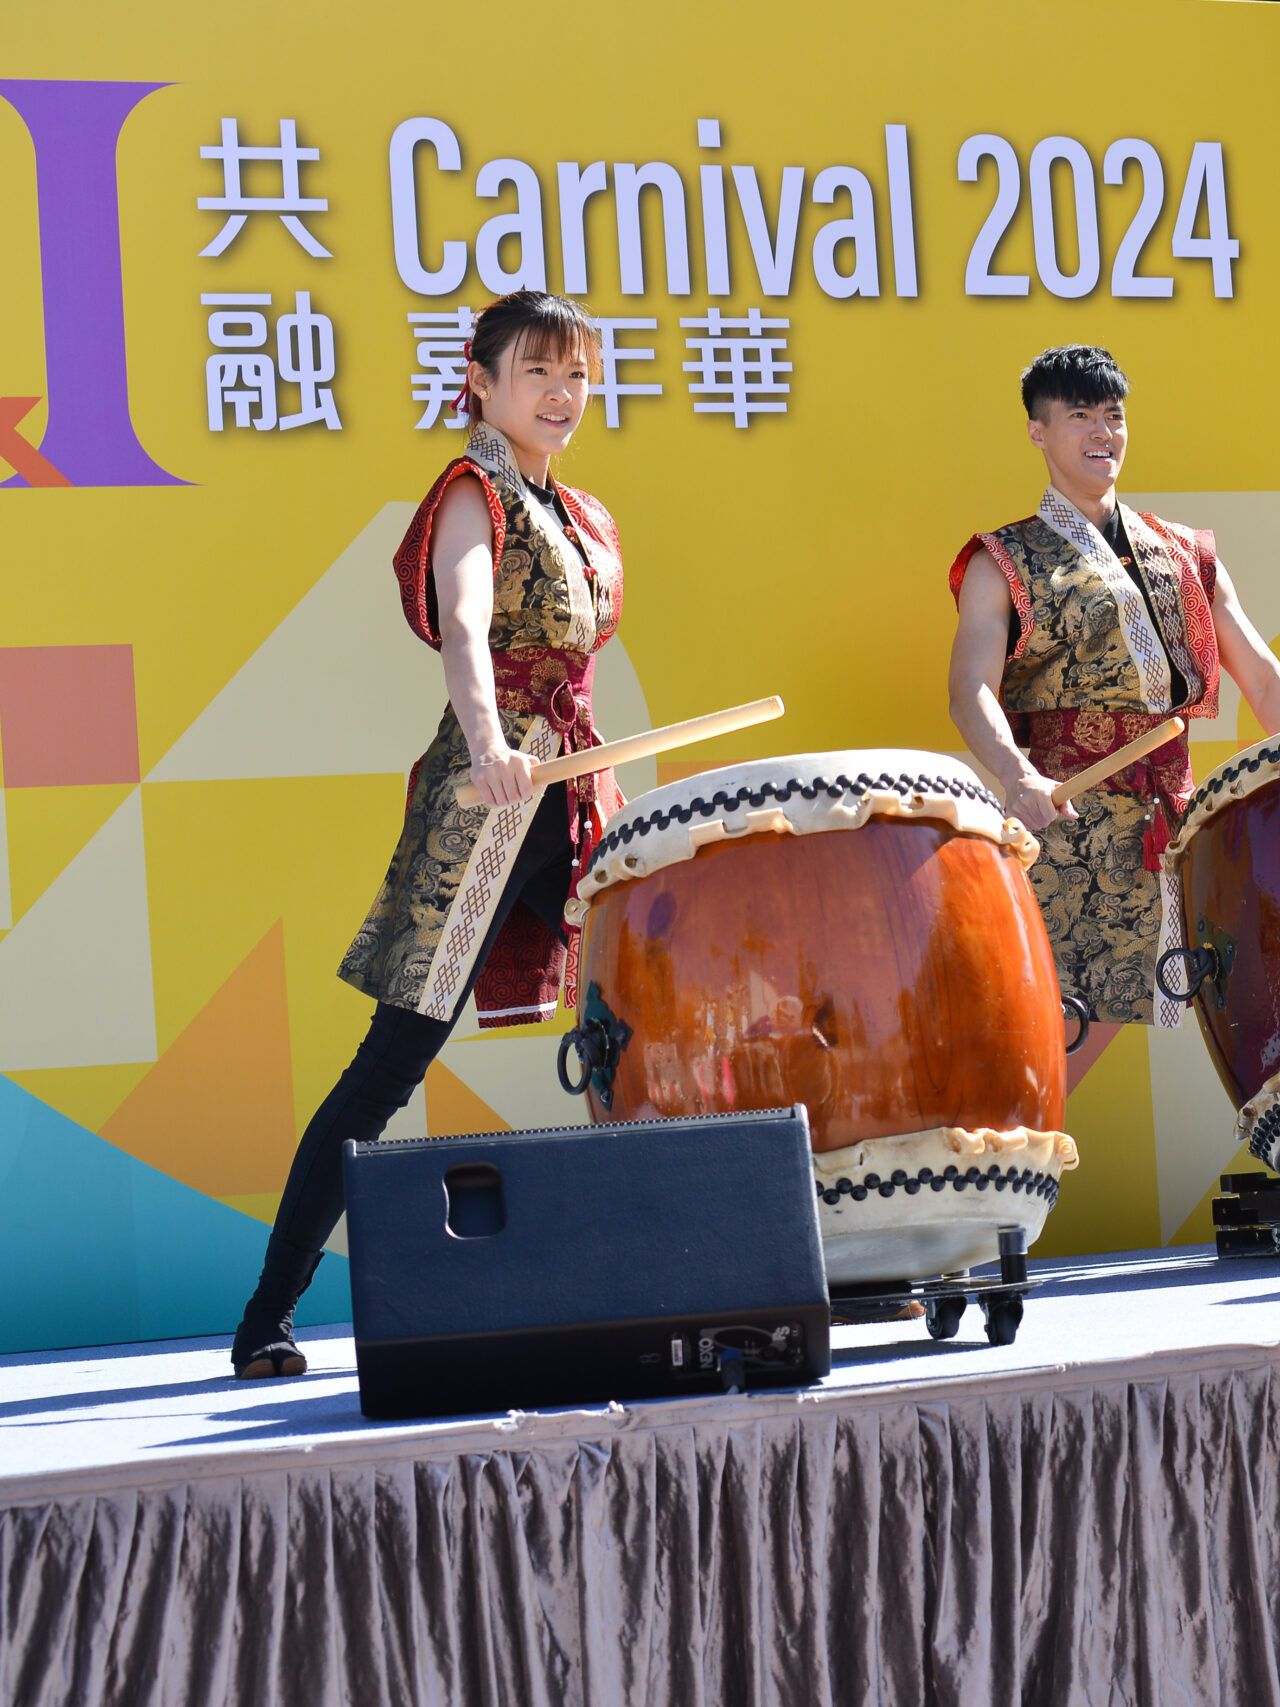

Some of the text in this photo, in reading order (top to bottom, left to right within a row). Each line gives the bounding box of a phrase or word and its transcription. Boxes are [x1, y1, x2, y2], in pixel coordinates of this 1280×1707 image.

[389, 116, 1240, 299] Carnival 2024
[698, 1337, 714, 1369] NEXO
